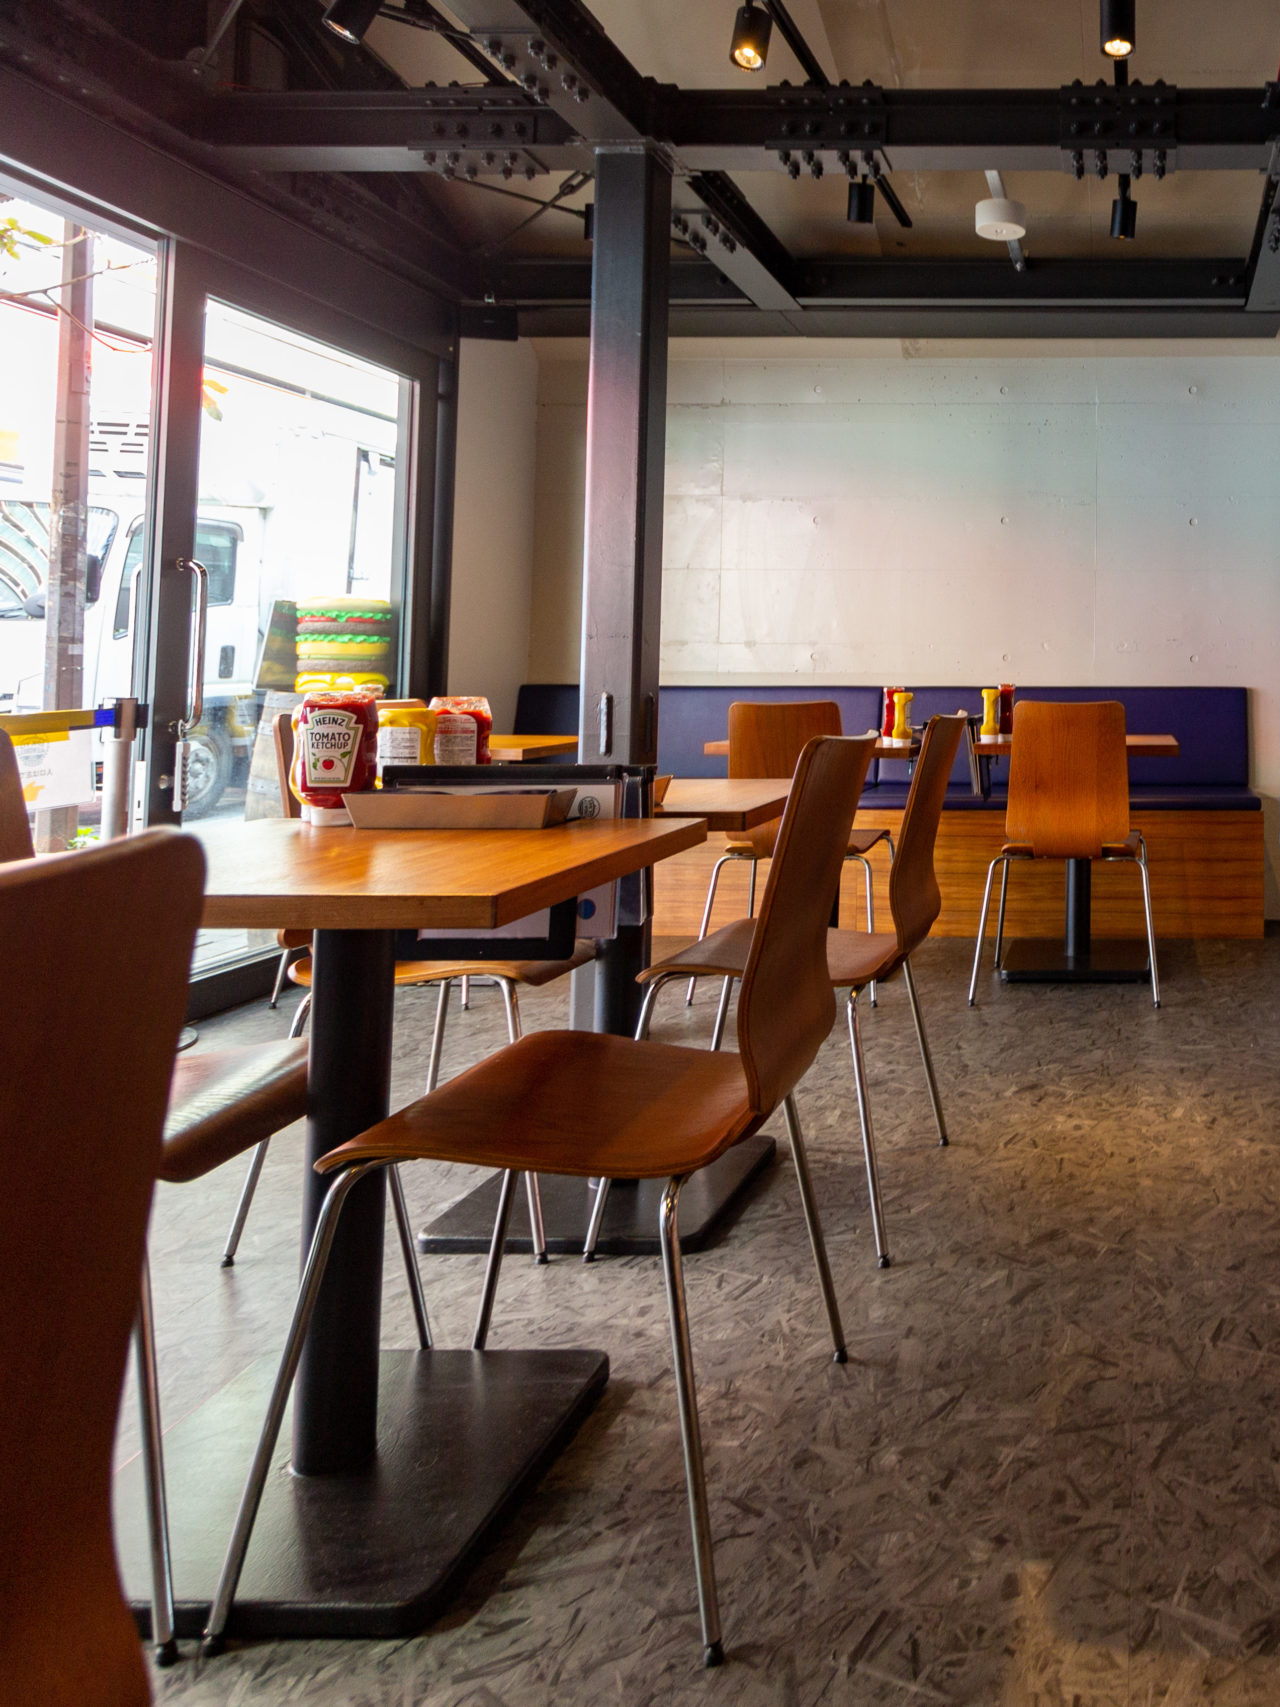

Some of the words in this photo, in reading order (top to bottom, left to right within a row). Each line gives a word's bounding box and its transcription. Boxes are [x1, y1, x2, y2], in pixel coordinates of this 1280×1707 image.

[315, 716, 346, 727] HEINZ
[310, 732, 351, 742] TOMATO
[311, 742, 349, 750] KETCHUP
